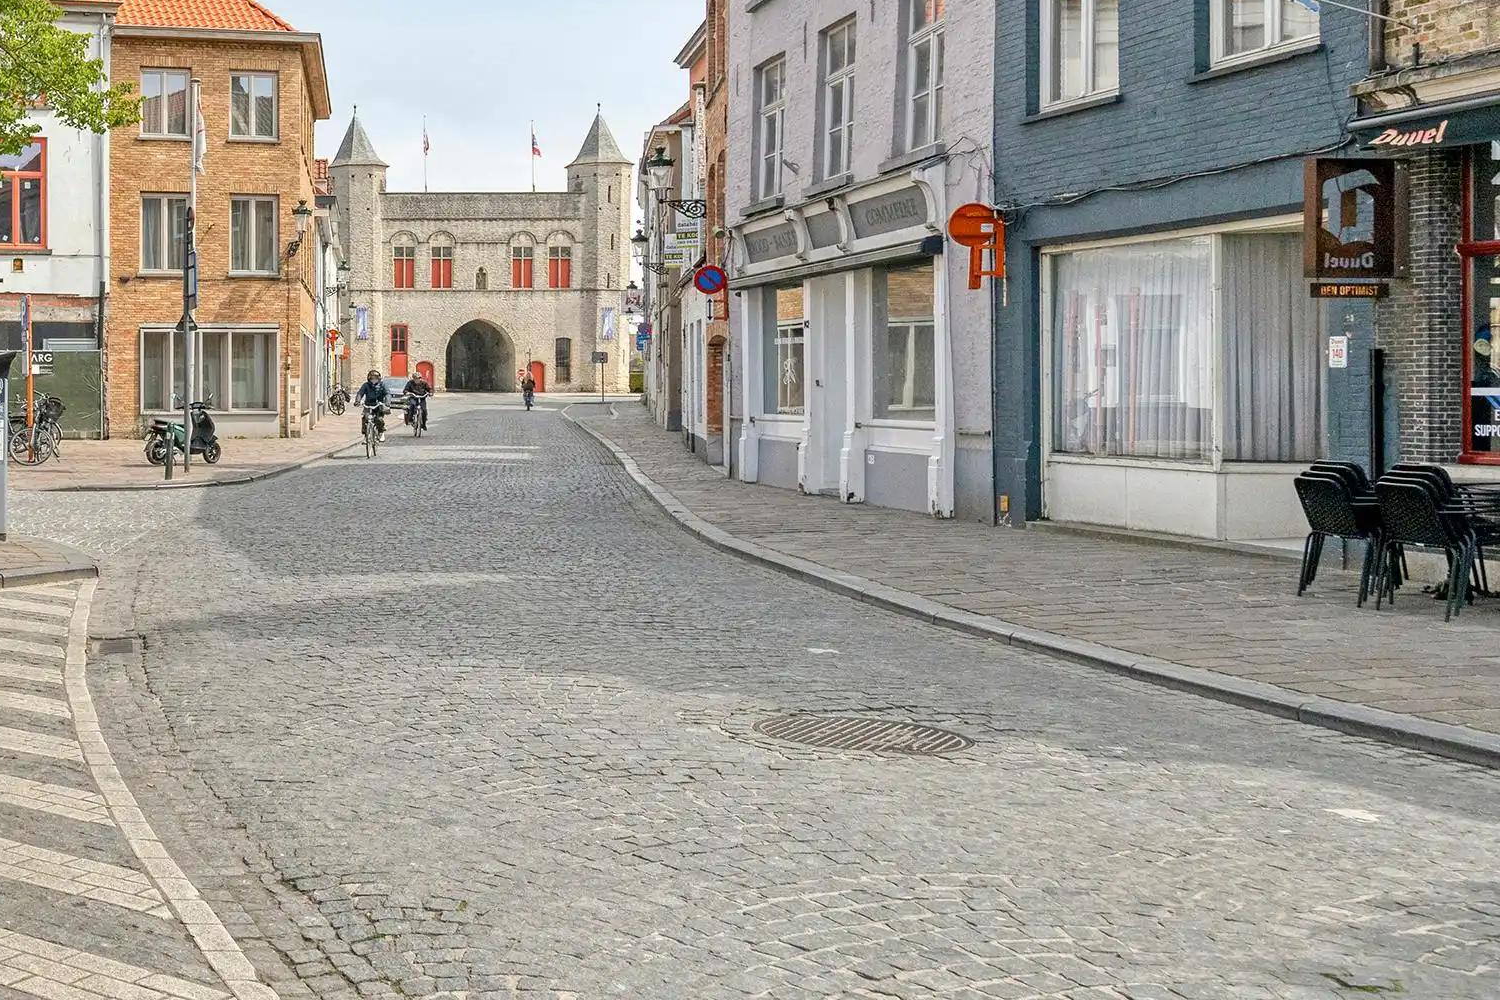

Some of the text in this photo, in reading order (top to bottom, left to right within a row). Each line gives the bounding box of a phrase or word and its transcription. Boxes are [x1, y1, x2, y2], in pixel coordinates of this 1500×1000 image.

[1368, 119, 1448, 146] Duvel
[1321, 285, 1378, 295] DEN OPTIMIST
